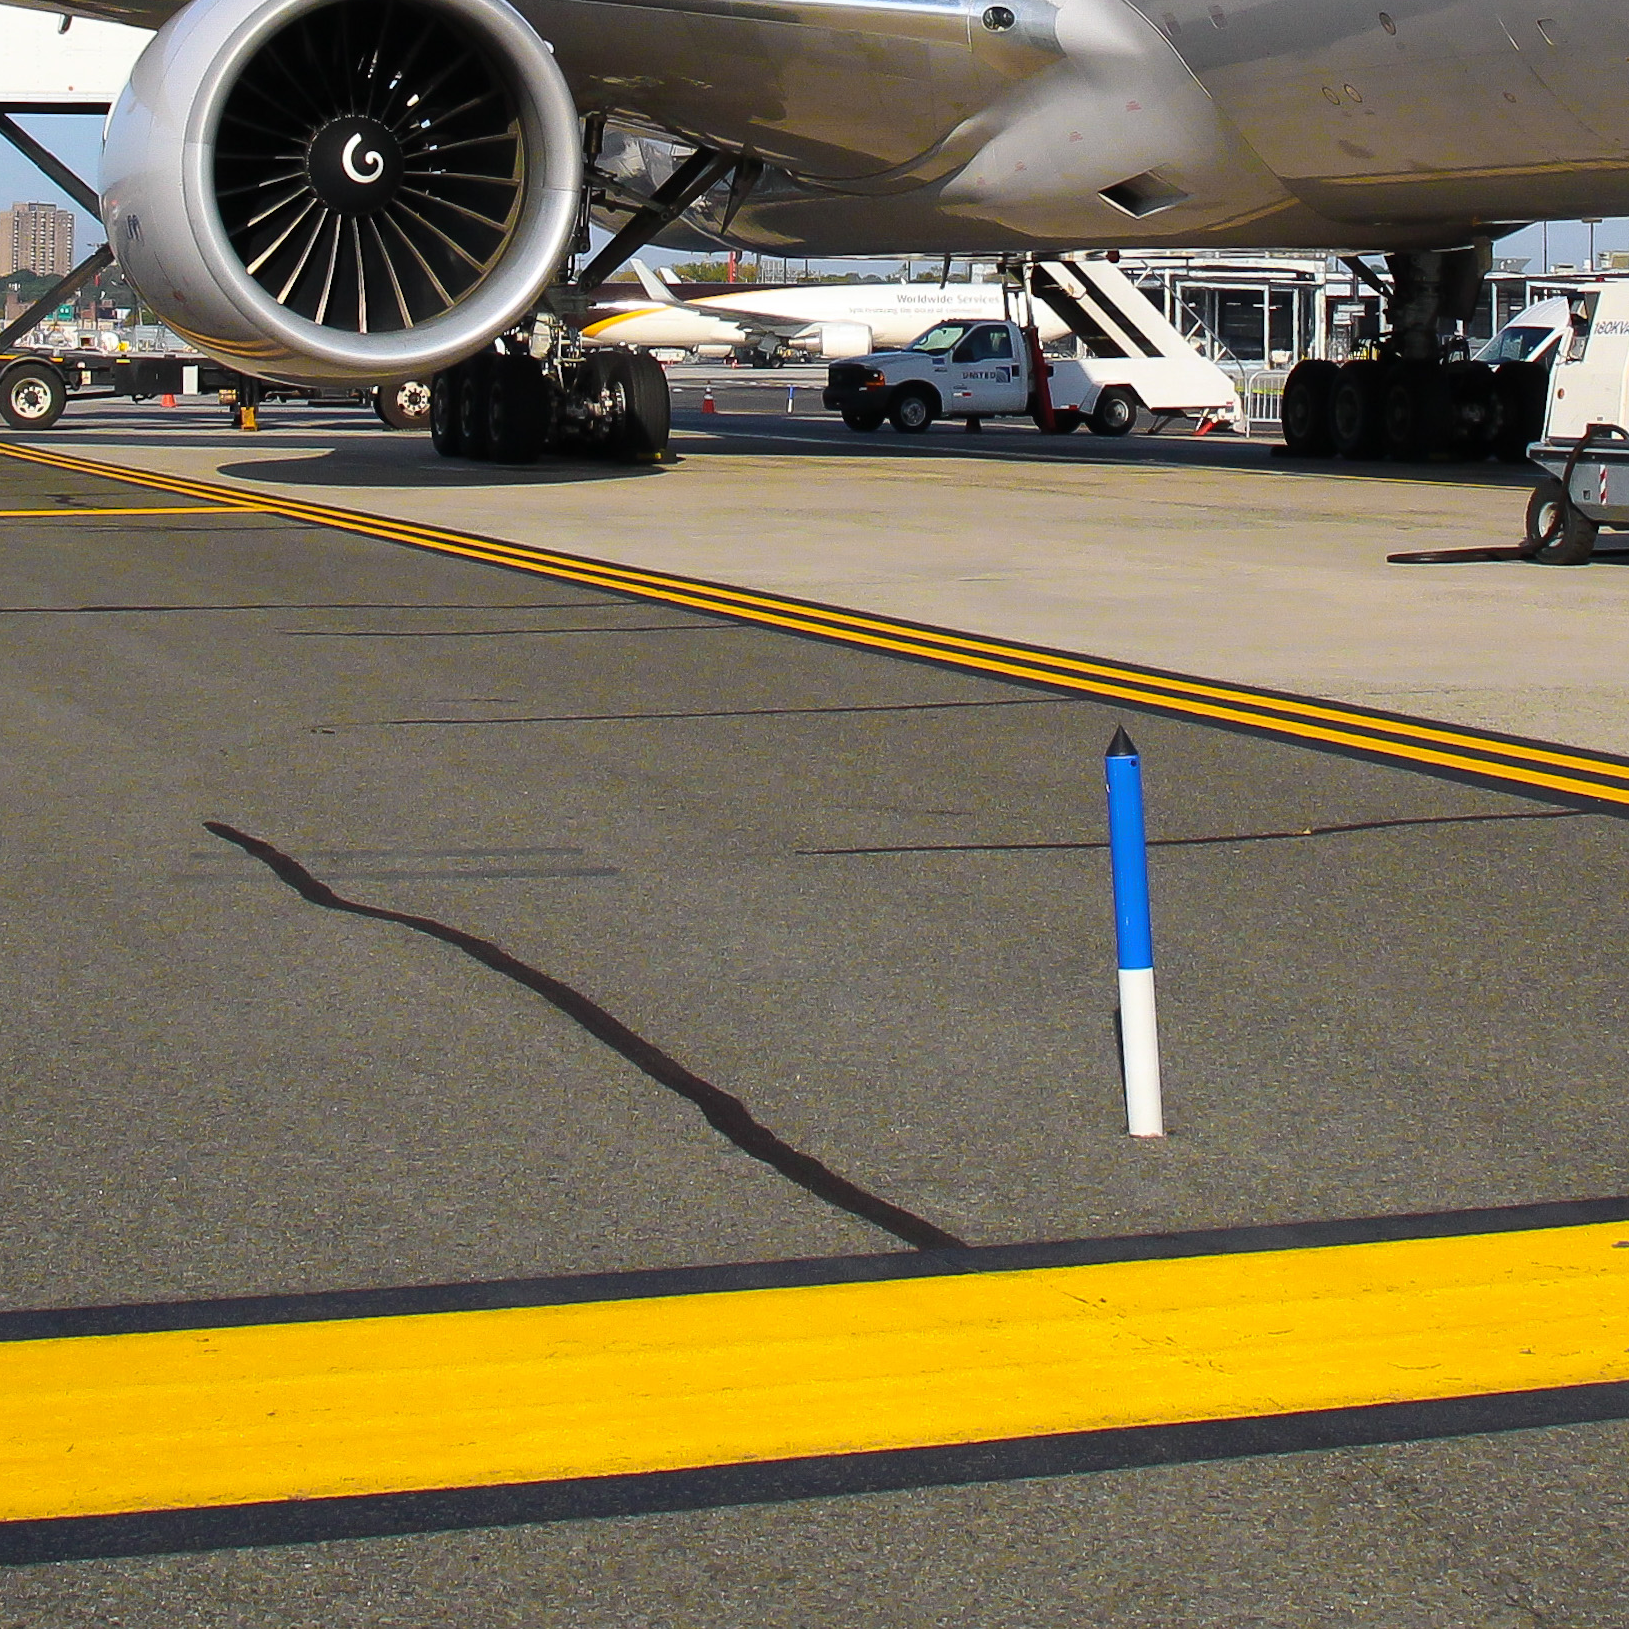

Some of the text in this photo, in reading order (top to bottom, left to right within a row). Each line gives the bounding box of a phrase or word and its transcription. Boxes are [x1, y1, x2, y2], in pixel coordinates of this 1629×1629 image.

[896, 294, 1001, 305] Worldwide Services
[962, 371, 996, 380] UNITED
